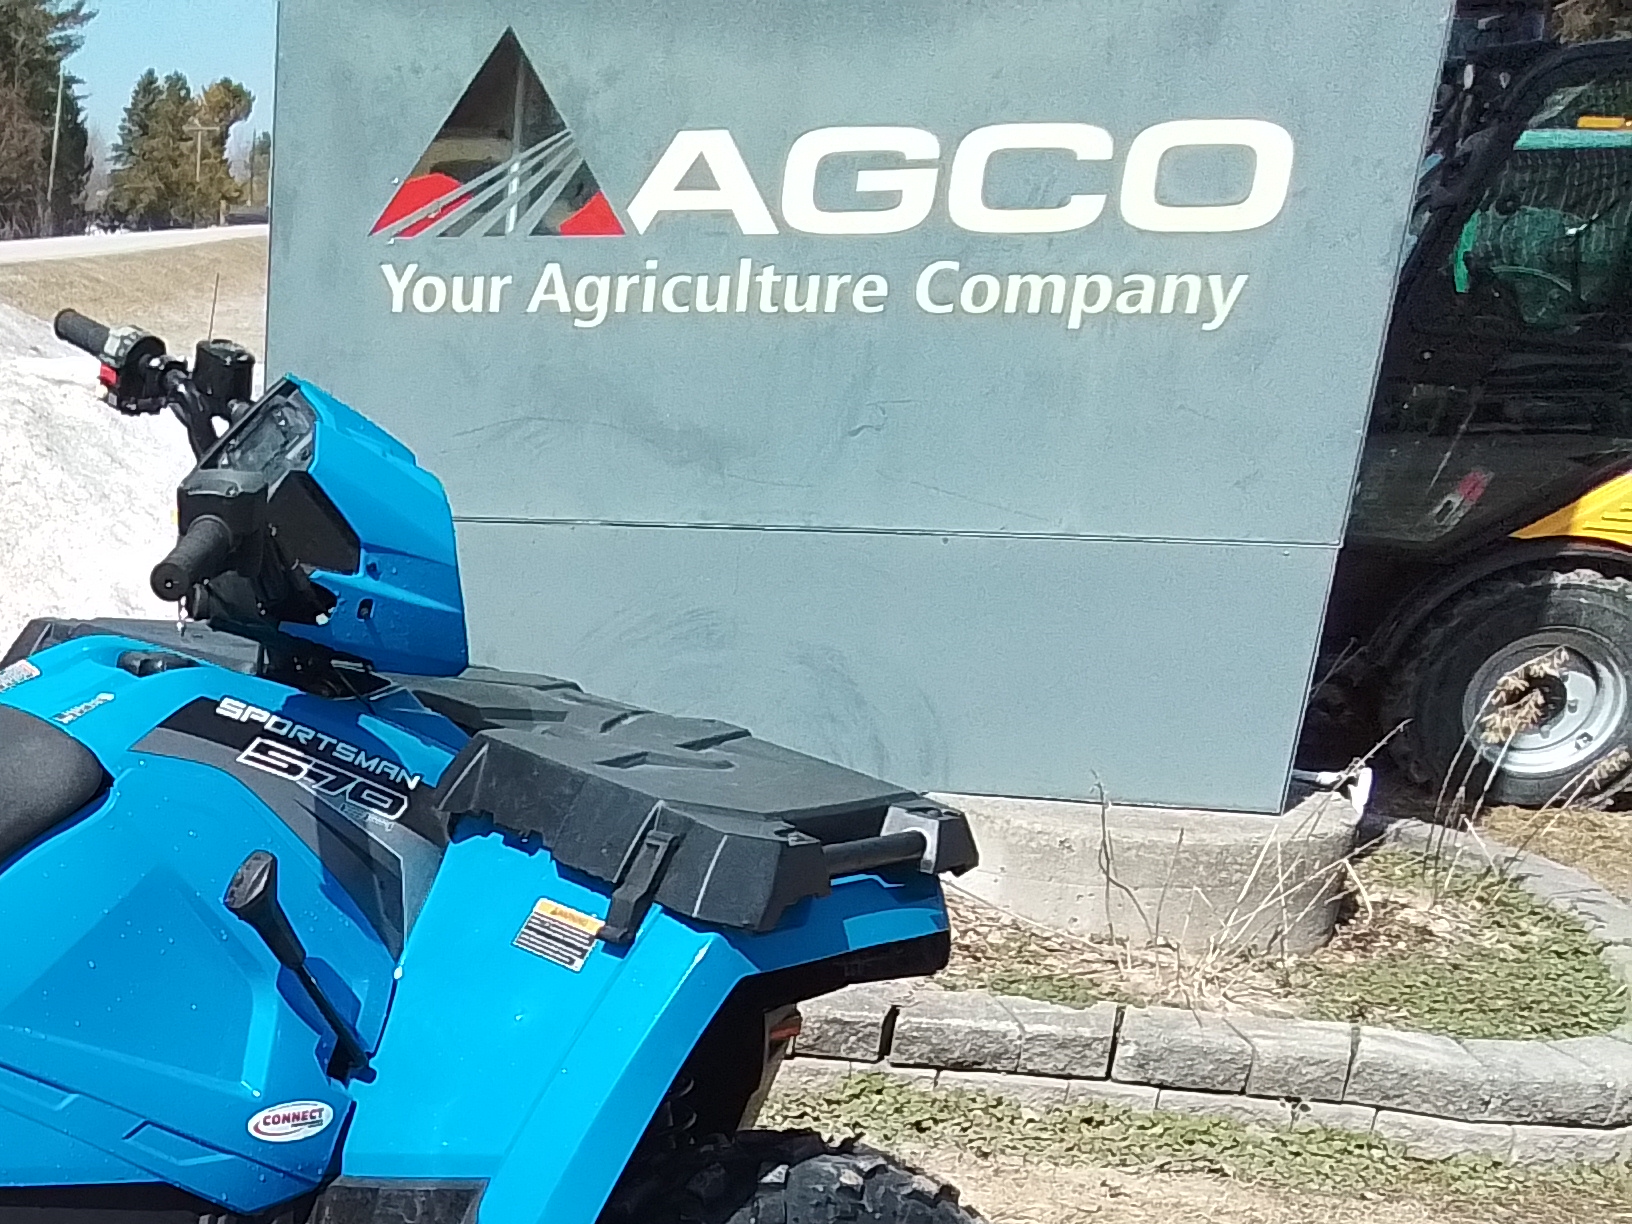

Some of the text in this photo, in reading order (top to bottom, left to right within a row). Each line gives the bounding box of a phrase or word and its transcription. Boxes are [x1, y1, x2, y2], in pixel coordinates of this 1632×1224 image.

[626, 118, 1295, 235] AGCO
[380, 258, 1249, 331] Your Agriculture Company
[214, 696, 422, 791] SPORTSMAN
[235, 736, 409, 821] 570
[262, 1107, 325, 1127] CONNECT
